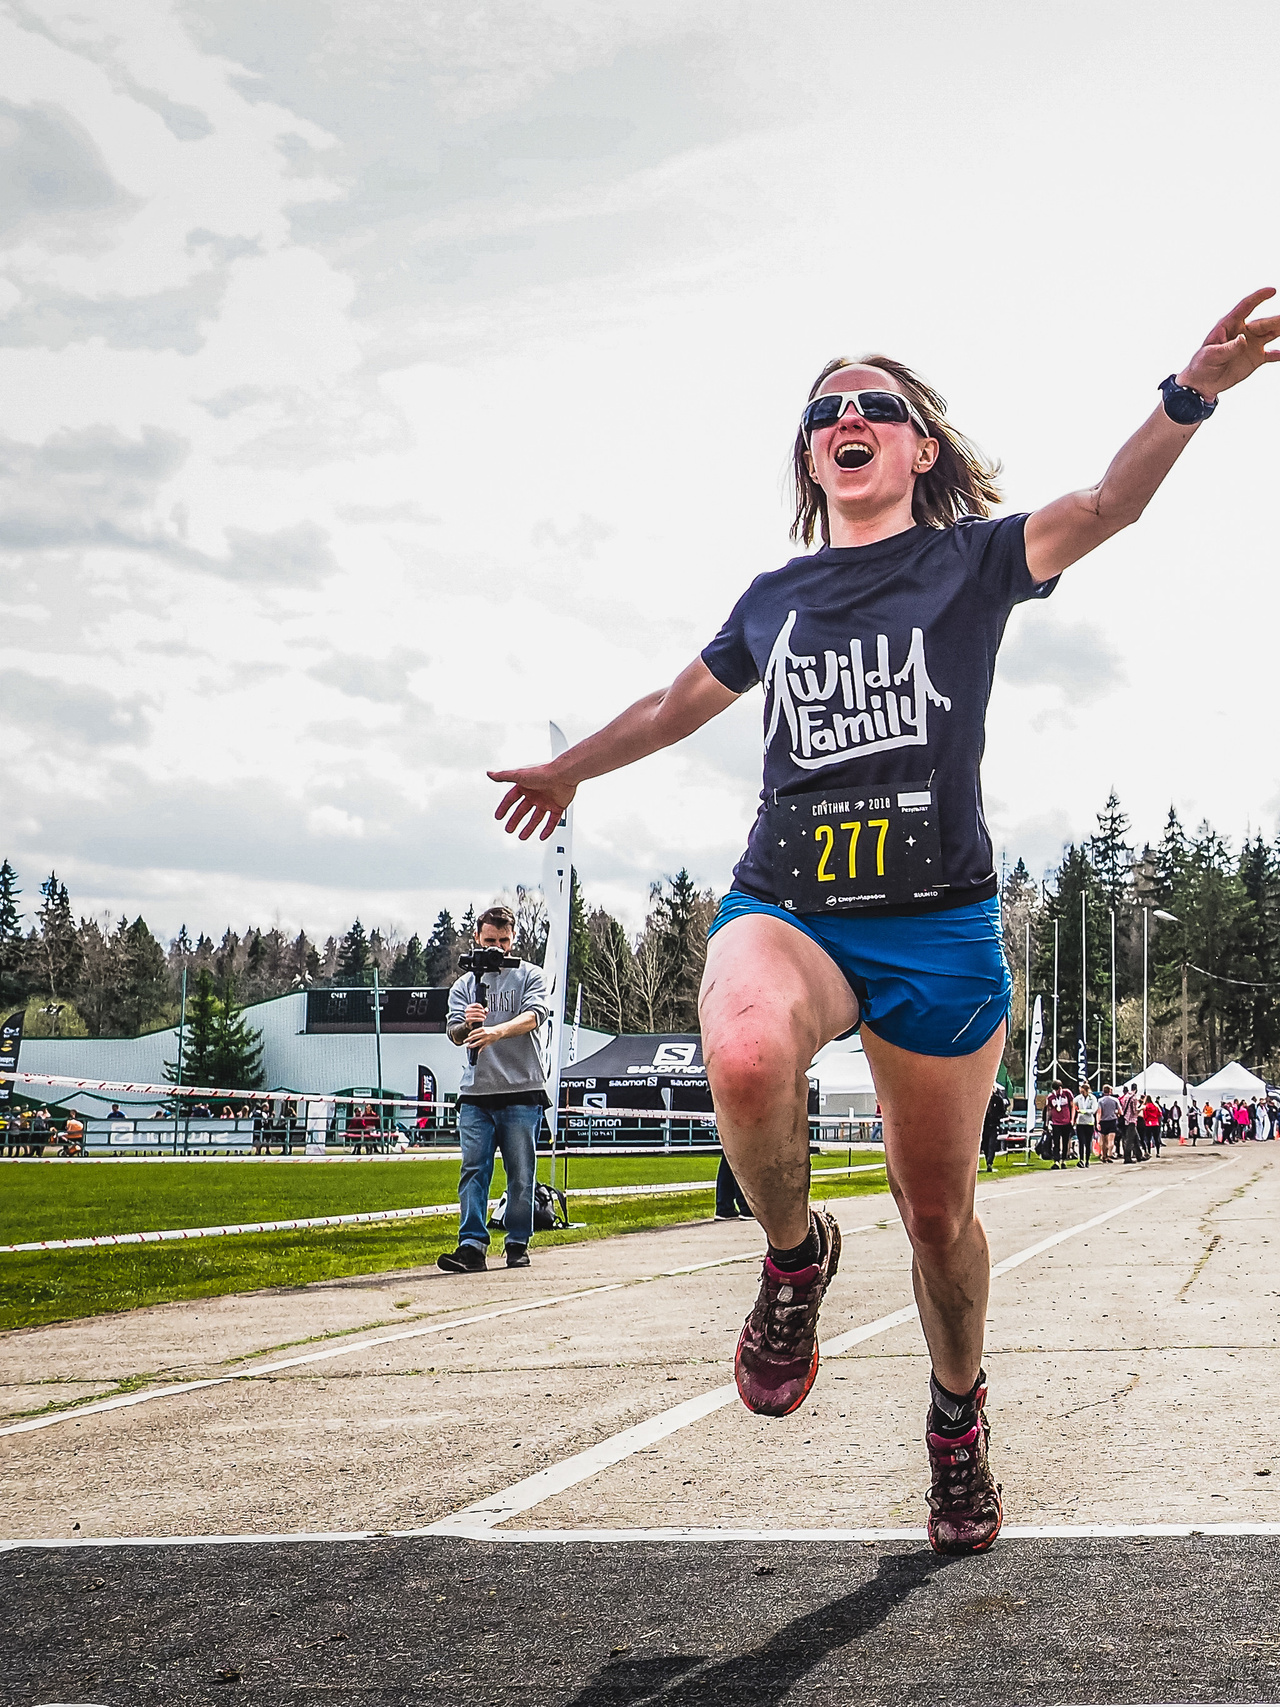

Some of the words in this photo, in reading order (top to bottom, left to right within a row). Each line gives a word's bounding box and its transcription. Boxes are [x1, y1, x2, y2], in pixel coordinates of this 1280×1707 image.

[787, 634, 891, 711] Wild
[797, 690, 928, 759] Family
[812, 800, 850, 816] СПУТНИК
[868, 797, 891, 810] 2018
[814, 818, 889, 882] 277
